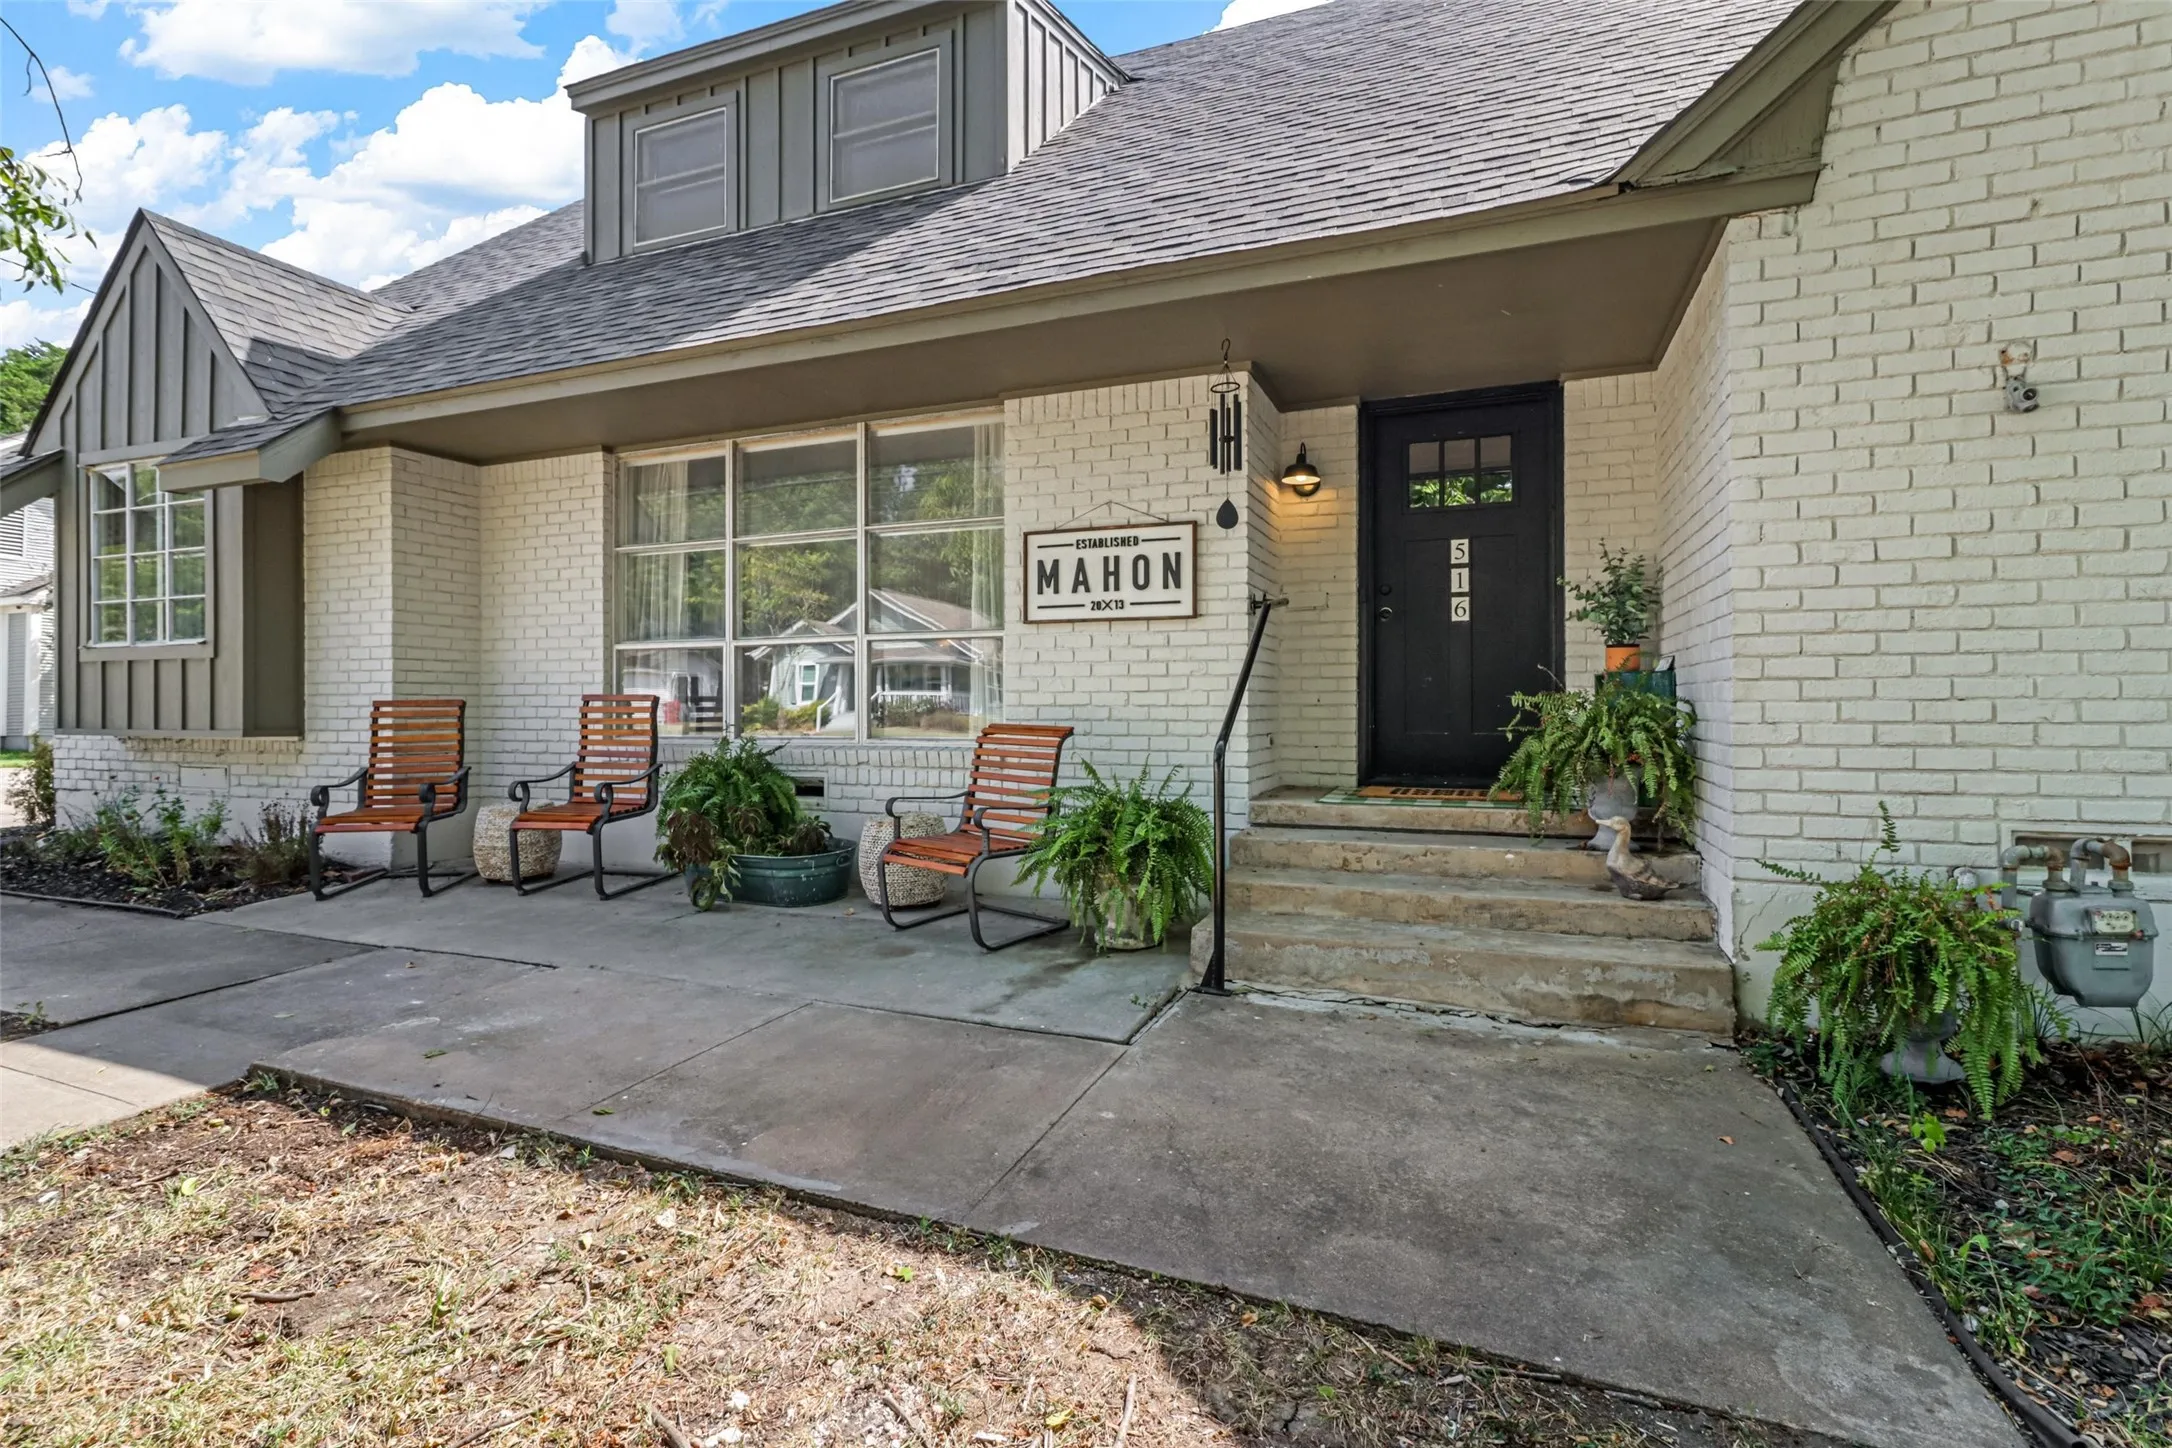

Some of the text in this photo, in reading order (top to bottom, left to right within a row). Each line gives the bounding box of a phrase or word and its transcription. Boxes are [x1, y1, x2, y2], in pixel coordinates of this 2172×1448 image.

[1075, 535, 1139, 550] ESTABLISHED
[1037, 551, 1182, 595] MAHON
[1454, 542, 1468, 618] 516
